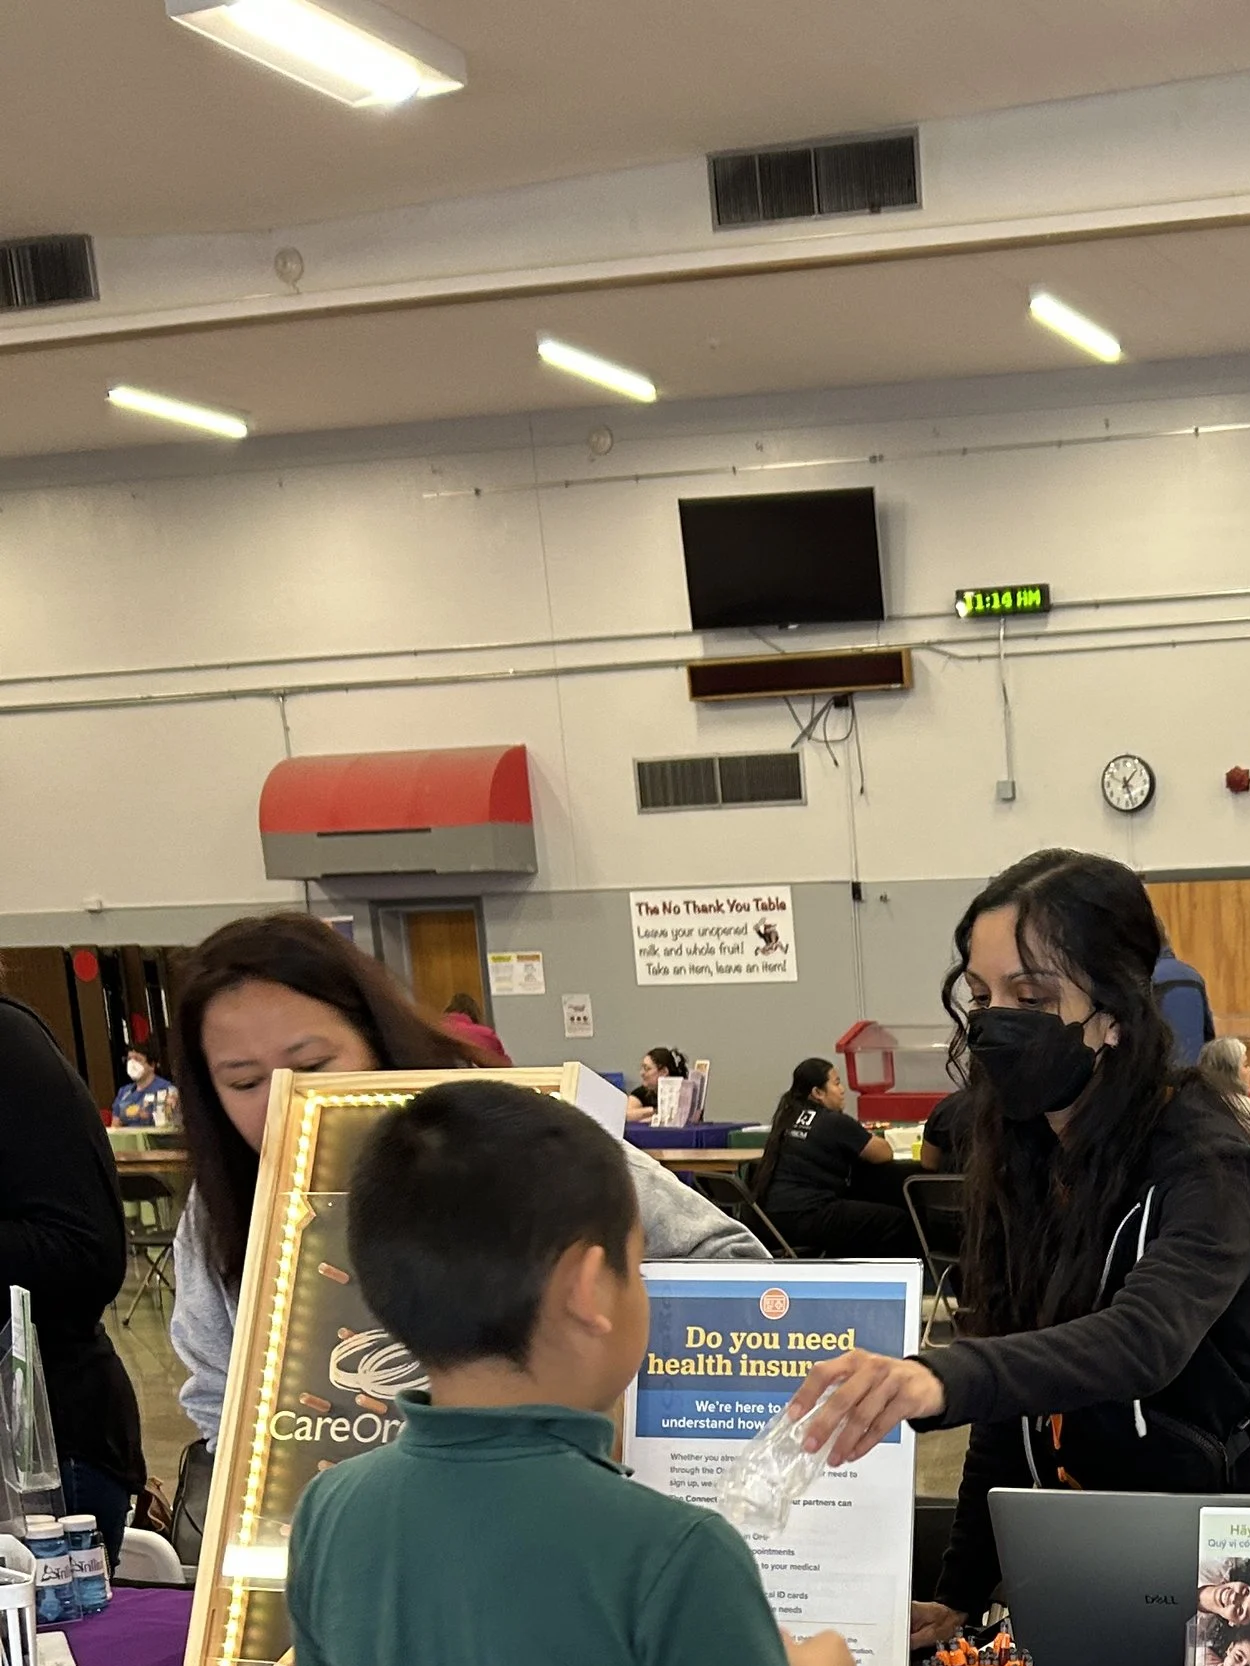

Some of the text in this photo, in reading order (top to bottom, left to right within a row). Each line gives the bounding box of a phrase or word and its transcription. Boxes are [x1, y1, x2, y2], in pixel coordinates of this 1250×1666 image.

[964, 592, 1012, 609] 11:14
[636, 897, 786, 916] The No Thank You Table
[638, 924, 748, 941] Leave your unopened
[639, 942, 743, 956] milk and whole fruit!
[647, 960, 786, 976] Take an item, leave an item!
[686, 1327, 855, 1353] Do you need
[647, 1354, 733, 1376] health
[695, 1401, 781, 1414] We're here to
[269, 1410, 407, 1443] CareOr
[662, 1417, 764, 1429] understand how
[705, 1455, 718, 1463] you
[670, 1467, 700, 1475] through
[669, 1480, 685, 1488] sign
[687, 1481, 699, 1489] up,
[686, 1495, 717, 1503] Connect
[1208, 1539, 1226, 1549] Quý
[1239, 1539, 1249, 1547] có
